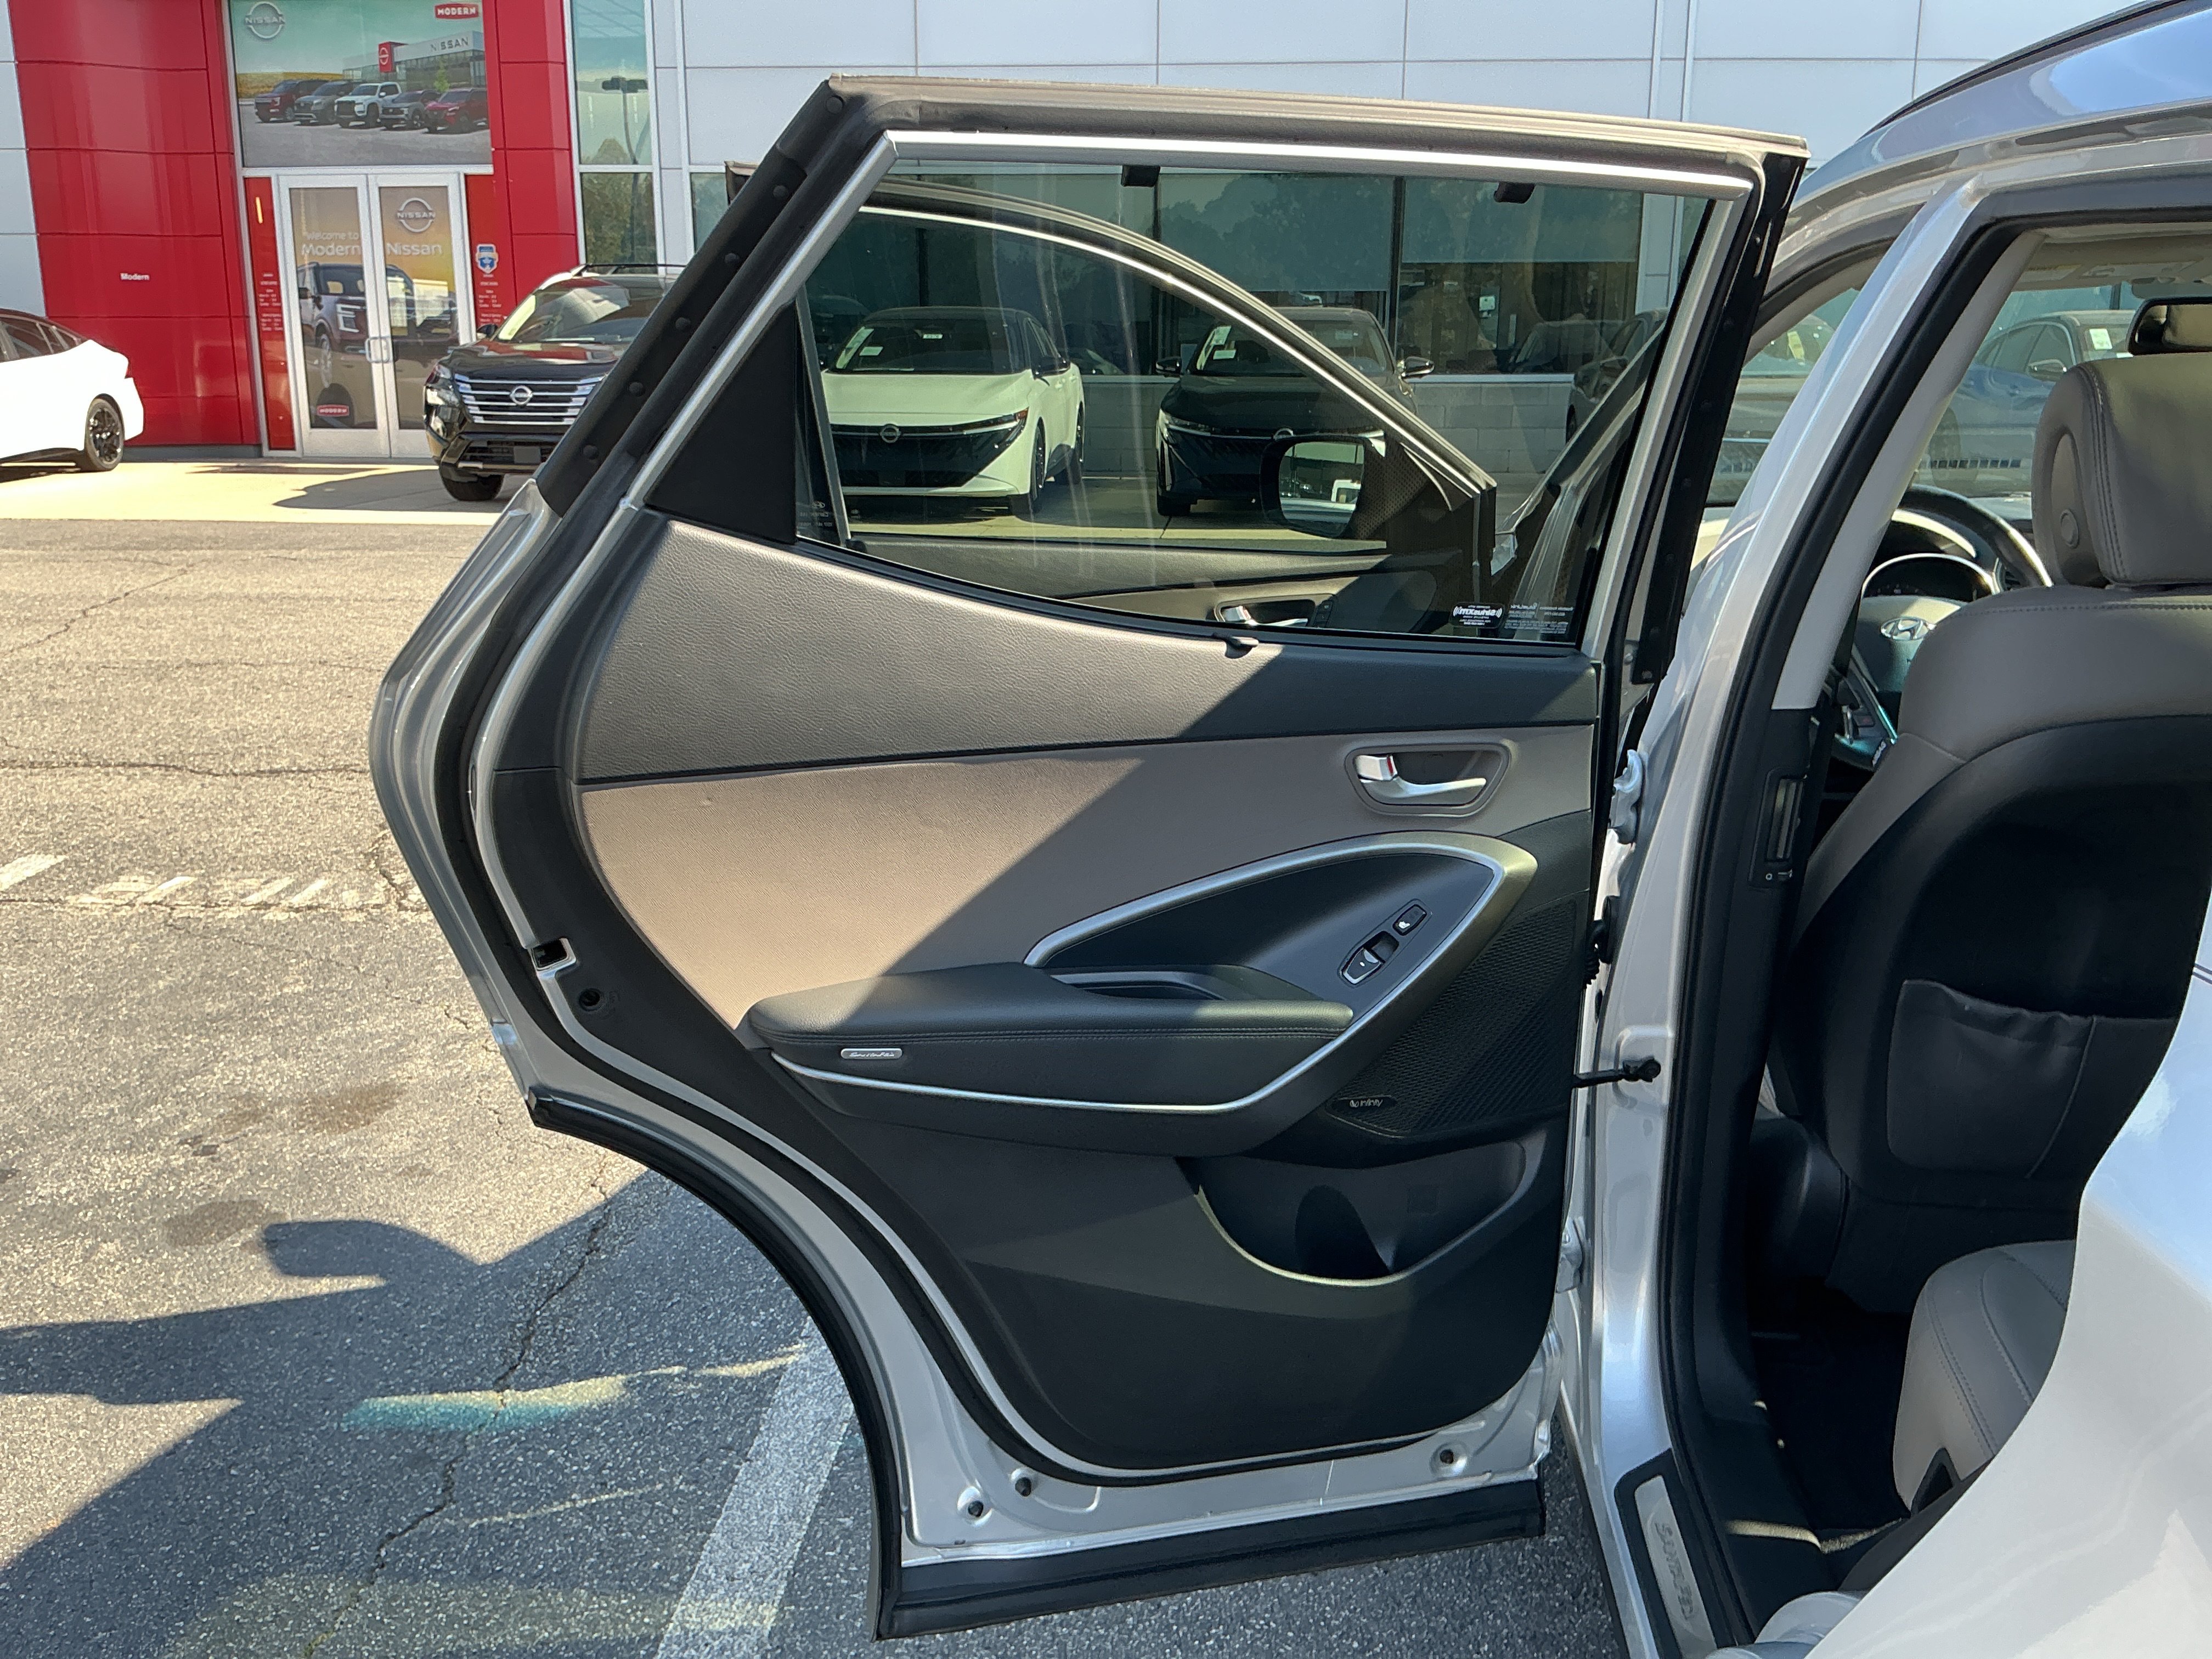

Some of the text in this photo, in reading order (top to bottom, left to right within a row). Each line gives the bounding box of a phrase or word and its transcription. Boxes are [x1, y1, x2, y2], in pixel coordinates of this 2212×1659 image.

[437, 7, 476, 16] MODERN
[302, 242, 443, 256] Modern Nissan
